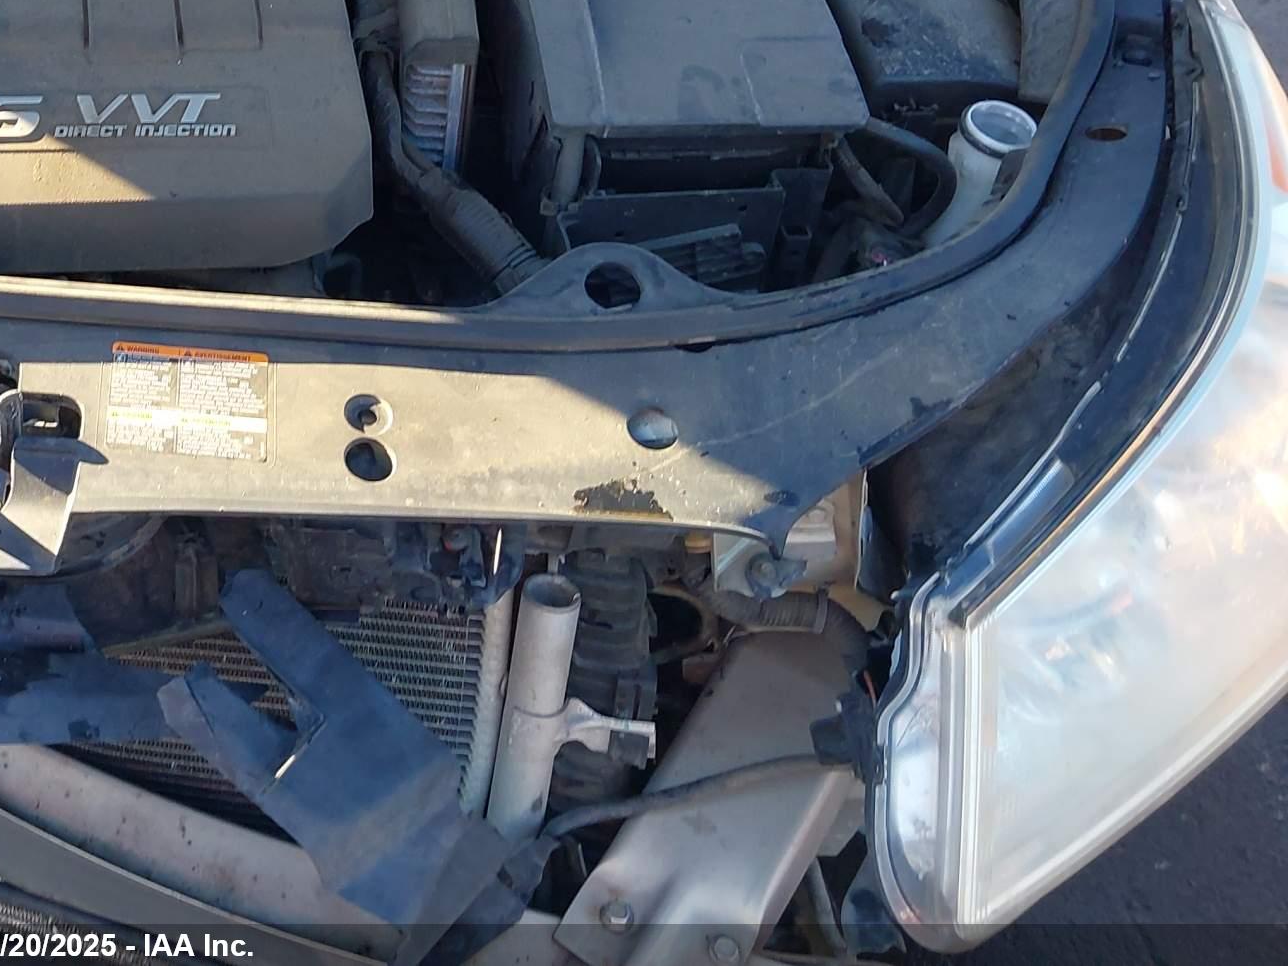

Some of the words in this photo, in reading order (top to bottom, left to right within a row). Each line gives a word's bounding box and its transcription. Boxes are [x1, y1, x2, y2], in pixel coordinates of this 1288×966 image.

[76, 92, 221, 124] VVT
[54, 124, 127, 138] DIRECT
[134, 123, 237, 138] INJECTION
